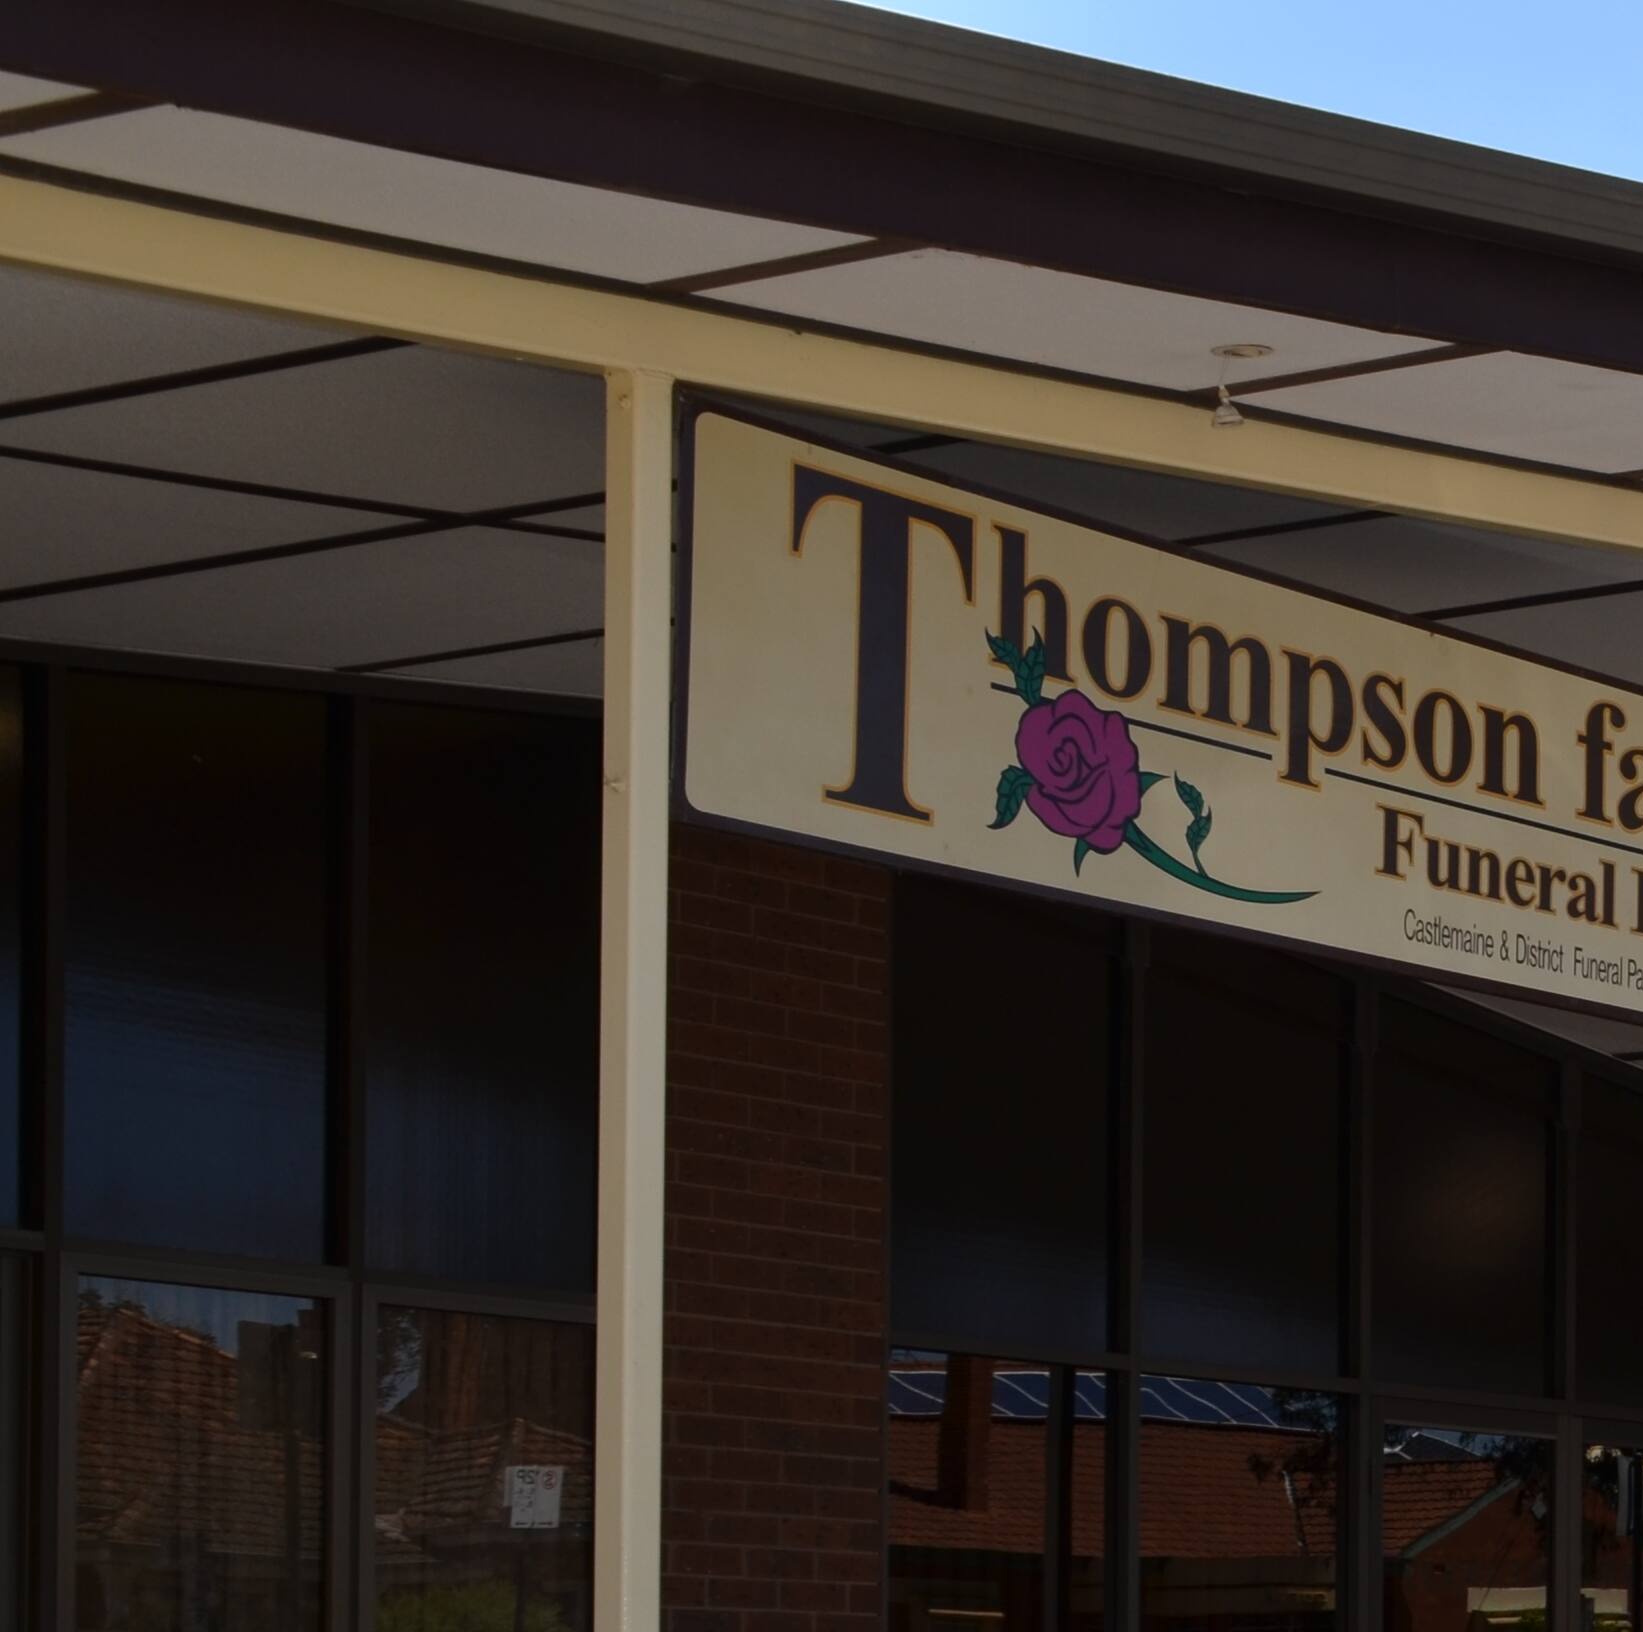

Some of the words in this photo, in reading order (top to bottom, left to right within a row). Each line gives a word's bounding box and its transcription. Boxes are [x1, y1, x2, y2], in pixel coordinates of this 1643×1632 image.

[788, 458, 1545, 827] Thompson
[1374, 801, 1619, 931] Funeral
[1403, 907, 1495, 959] Castlemaine
[1499, 929, 1511, 962] &
[1515, 933, 1564, 975] District
[1573, 946, 1624, 987] Funeral
